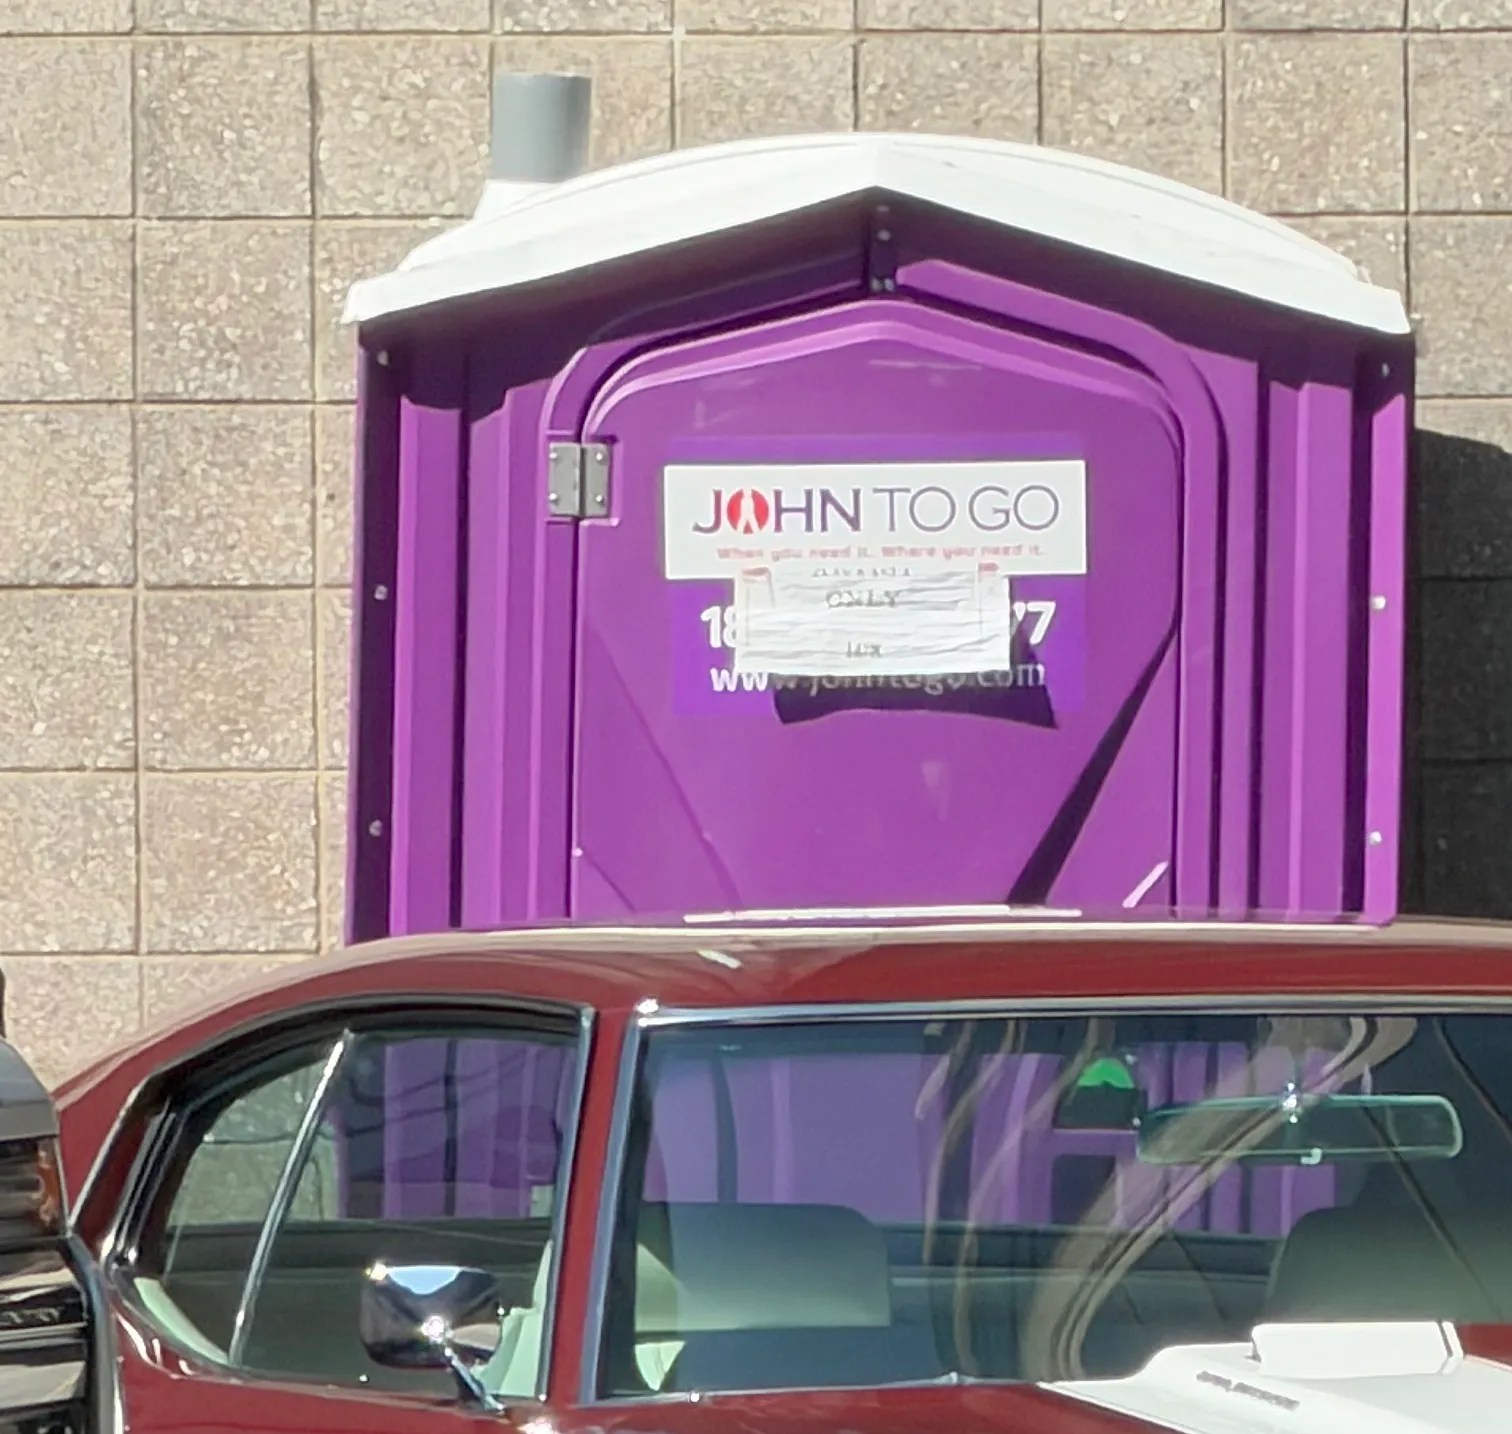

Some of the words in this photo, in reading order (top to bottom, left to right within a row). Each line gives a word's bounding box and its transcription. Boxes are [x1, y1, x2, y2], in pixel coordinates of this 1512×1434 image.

[692, 485, 861, 534] JOHN
[872, 484, 957, 533] TO
[968, 483, 1060, 532] GO
[716, 546, 764, 559] When
[771, 548, 803, 562] you
[809, 546, 851, 559] need
[881, 545, 936, 558] Where
[942, 546, 975, 560] you
[980, 543, 1024, 557] need
